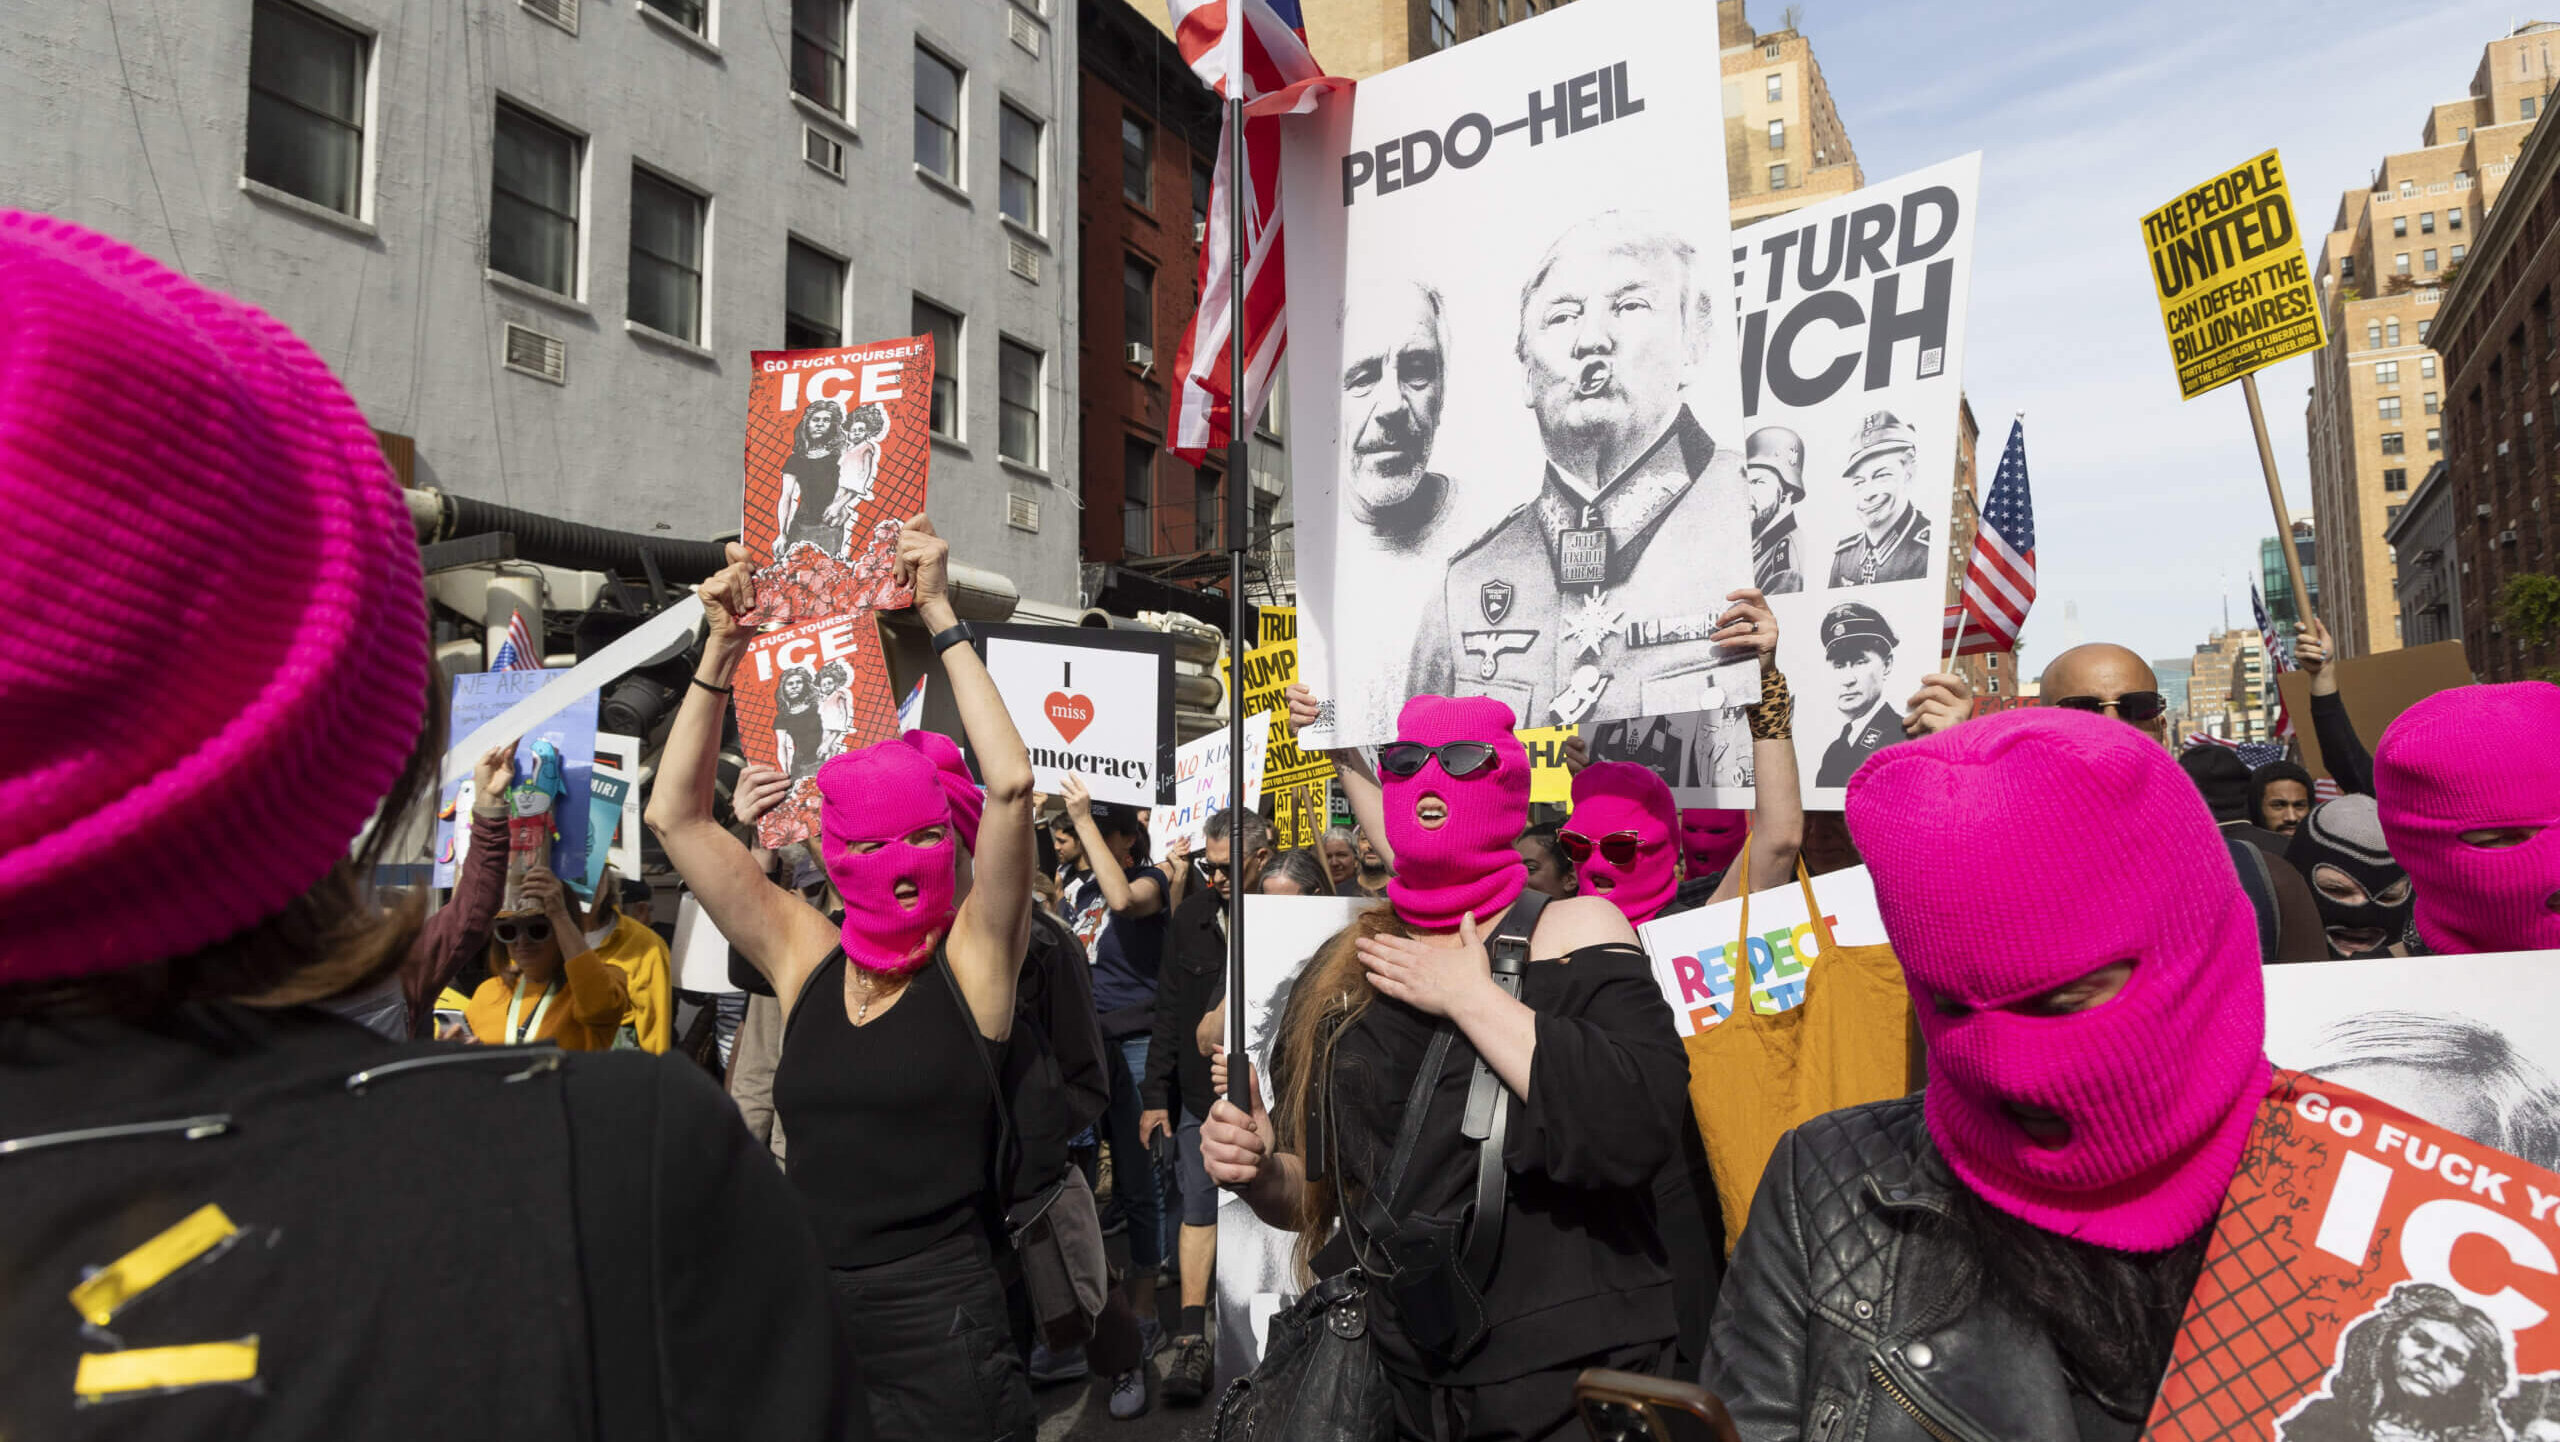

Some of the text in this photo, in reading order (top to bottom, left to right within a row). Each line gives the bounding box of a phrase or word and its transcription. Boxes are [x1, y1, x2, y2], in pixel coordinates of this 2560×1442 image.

[2144, 154, 2282, 248] THE PEOPLE
[1761, 184, 1960, 304] TURD
[2153, 193, 2294, 298] UNITED
[2167, 254, 2307, 334] CAN DEFEAT THE
[1737, 258, 1954, 418] ICH
[2172, 284, 2315, 365] BILLIONAIRES!
[763, 343, 924, 373] GO FUCK YOURSELF
[2181, 366, 2202, 380] PARTY
[2203, 360, 2217, 373] FOR
[2217, 341, 2256, 366] SOCIALISM
[2264, 322, 2315, 346] LIBERATION
[2200, 371, 2214, 384] THE
[2214, 362, 2236, 381] FIGHT!
[2260, 333, 2317, 360] PSLWEB.ORG
[779, 361, 905, 412] ICE
[754, 622, 859, 683] ICE
[759, 629, 796, 648] FUCK
[799, 613, 864, 635] YOURSE
[1261, 612, 1297, 642] TRU
[496, 671, 537, 695] ARE
[1063, 661, 1072, 688] I
[1052, 702, 1087, 721] miss
[1026, 746, 1153, 790] mocracy
[1175, 754, 1199, 781] NO
[1205, 734, 1253, 768] KINS
[1196, 774, 1214, 795] IN
[1671, 914, 1839, 1005] RESPECT
[2295, 1092, 2363, 1138] GO
[2374, 1123, 2512, 1205] FUCK
